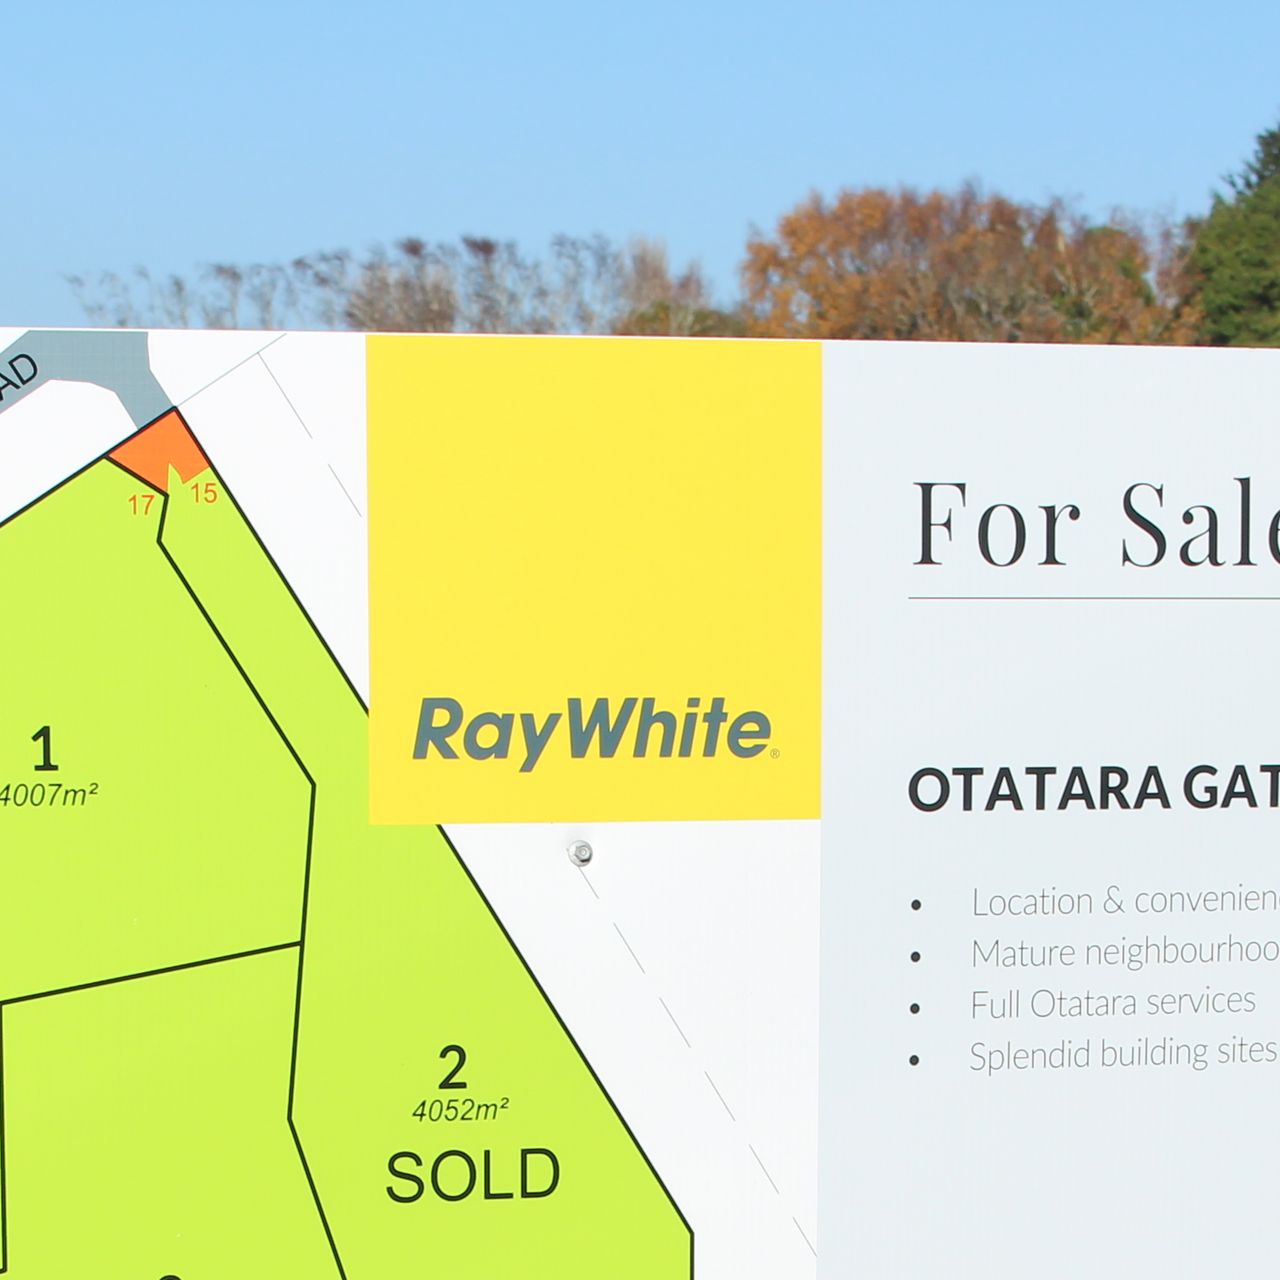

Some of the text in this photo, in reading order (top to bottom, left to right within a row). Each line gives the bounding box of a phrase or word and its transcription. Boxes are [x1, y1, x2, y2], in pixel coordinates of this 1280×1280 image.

[129, 494, 155, 514] 17
[191, 482, 218, 503] 15
[913, 483, 1080, 567] For
[32, 726, 58, 771] 1
[909, 766, 1171, 812] OTATARA
[974, 887, 1092, 916] Location
[1104, 885, 1125, 913] &
[973, 939, 1075, 967] Mature
[973, 986, 1255, 1019] Full Otatara services
[439, 1045, 467, 1089] 2
[970, 1036, 1277, 1076] Splendid building sites
[386, 1148, 559, 1203] SOLD
